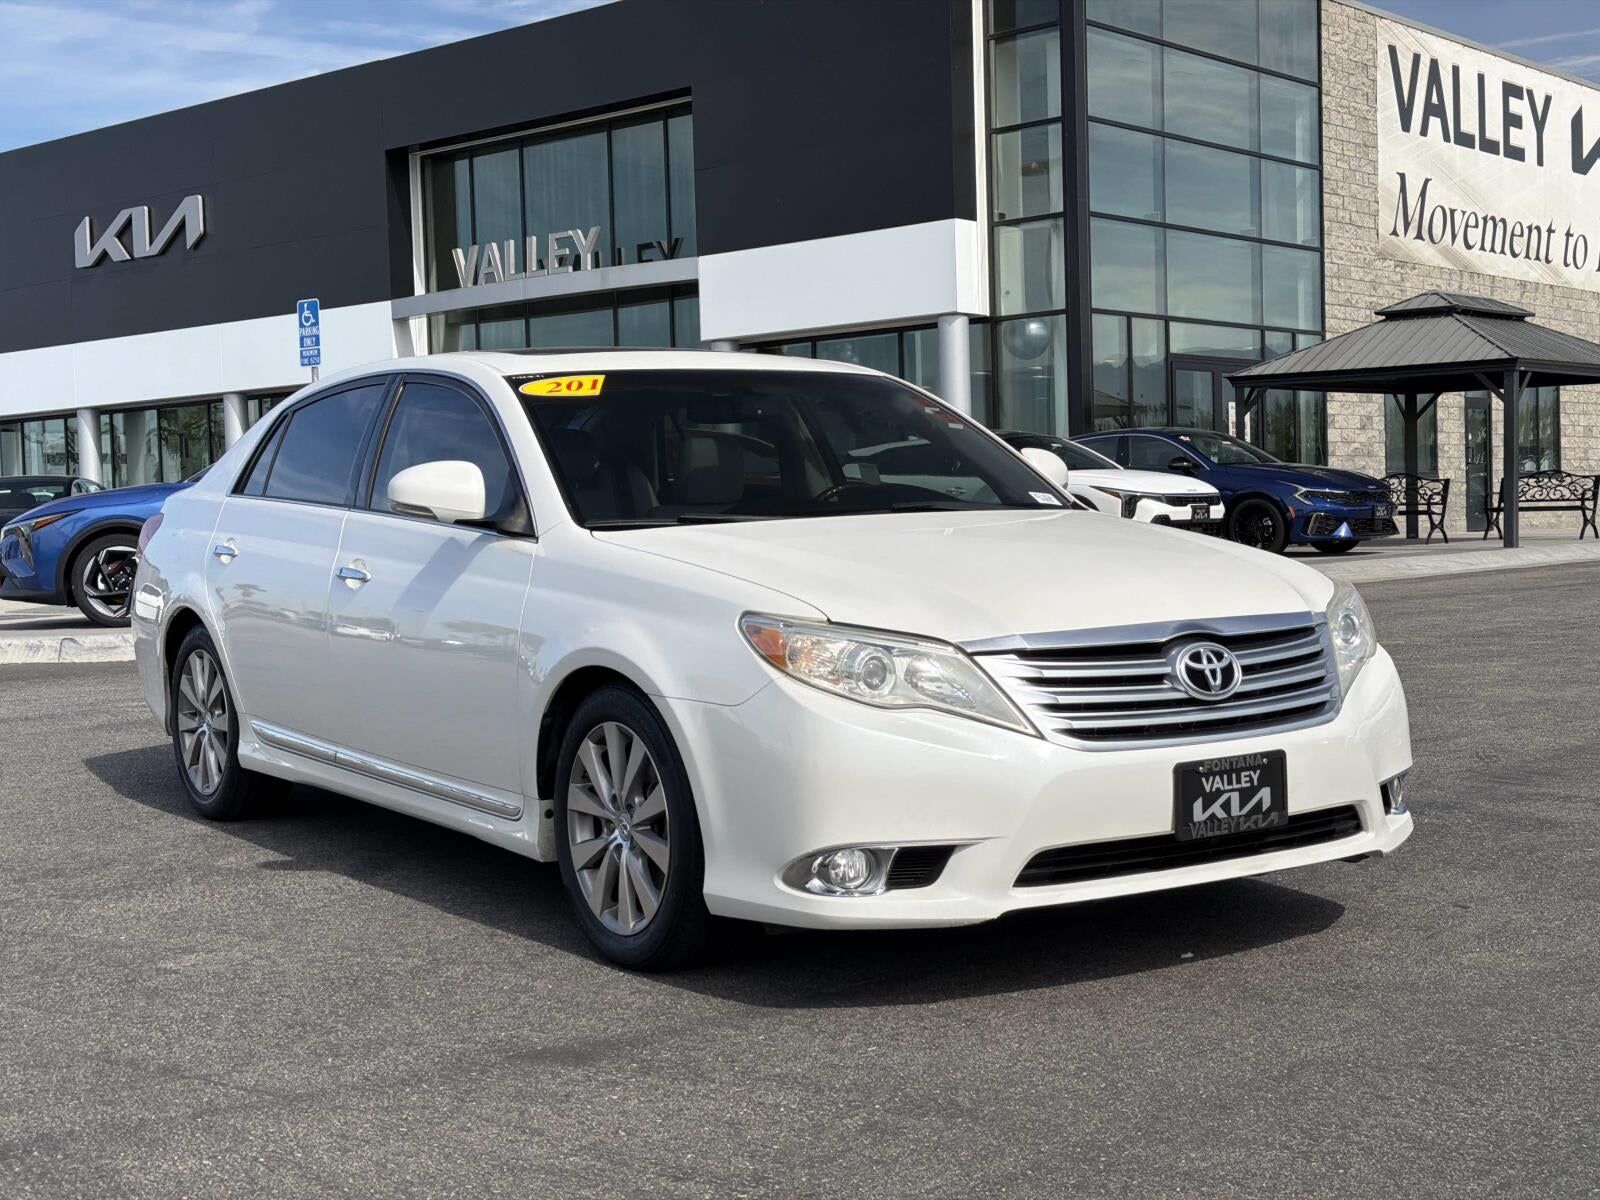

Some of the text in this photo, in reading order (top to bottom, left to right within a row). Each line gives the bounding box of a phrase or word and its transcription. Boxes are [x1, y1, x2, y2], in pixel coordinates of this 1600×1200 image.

[1387, 44, 1553, 168] VALLEY
[74, 194, 205, 269] KIA
[1389, 171, 1556, 265] Movement
[1562, 222, 1589, 270] to
[451, 226, 601, 288] VALLEY
[298, 326, 320, 337] PARKING
[303, 336, 316, 347] ONLY
[545, 379, 599, 394] 201
[1203, 754, 1263, 773] FONTANA
[1202, 769, 1260, 793] VALLEY
[1193, 786, 1271, 822] KIA
[1189, 816, 1239, 840] VALLEY
